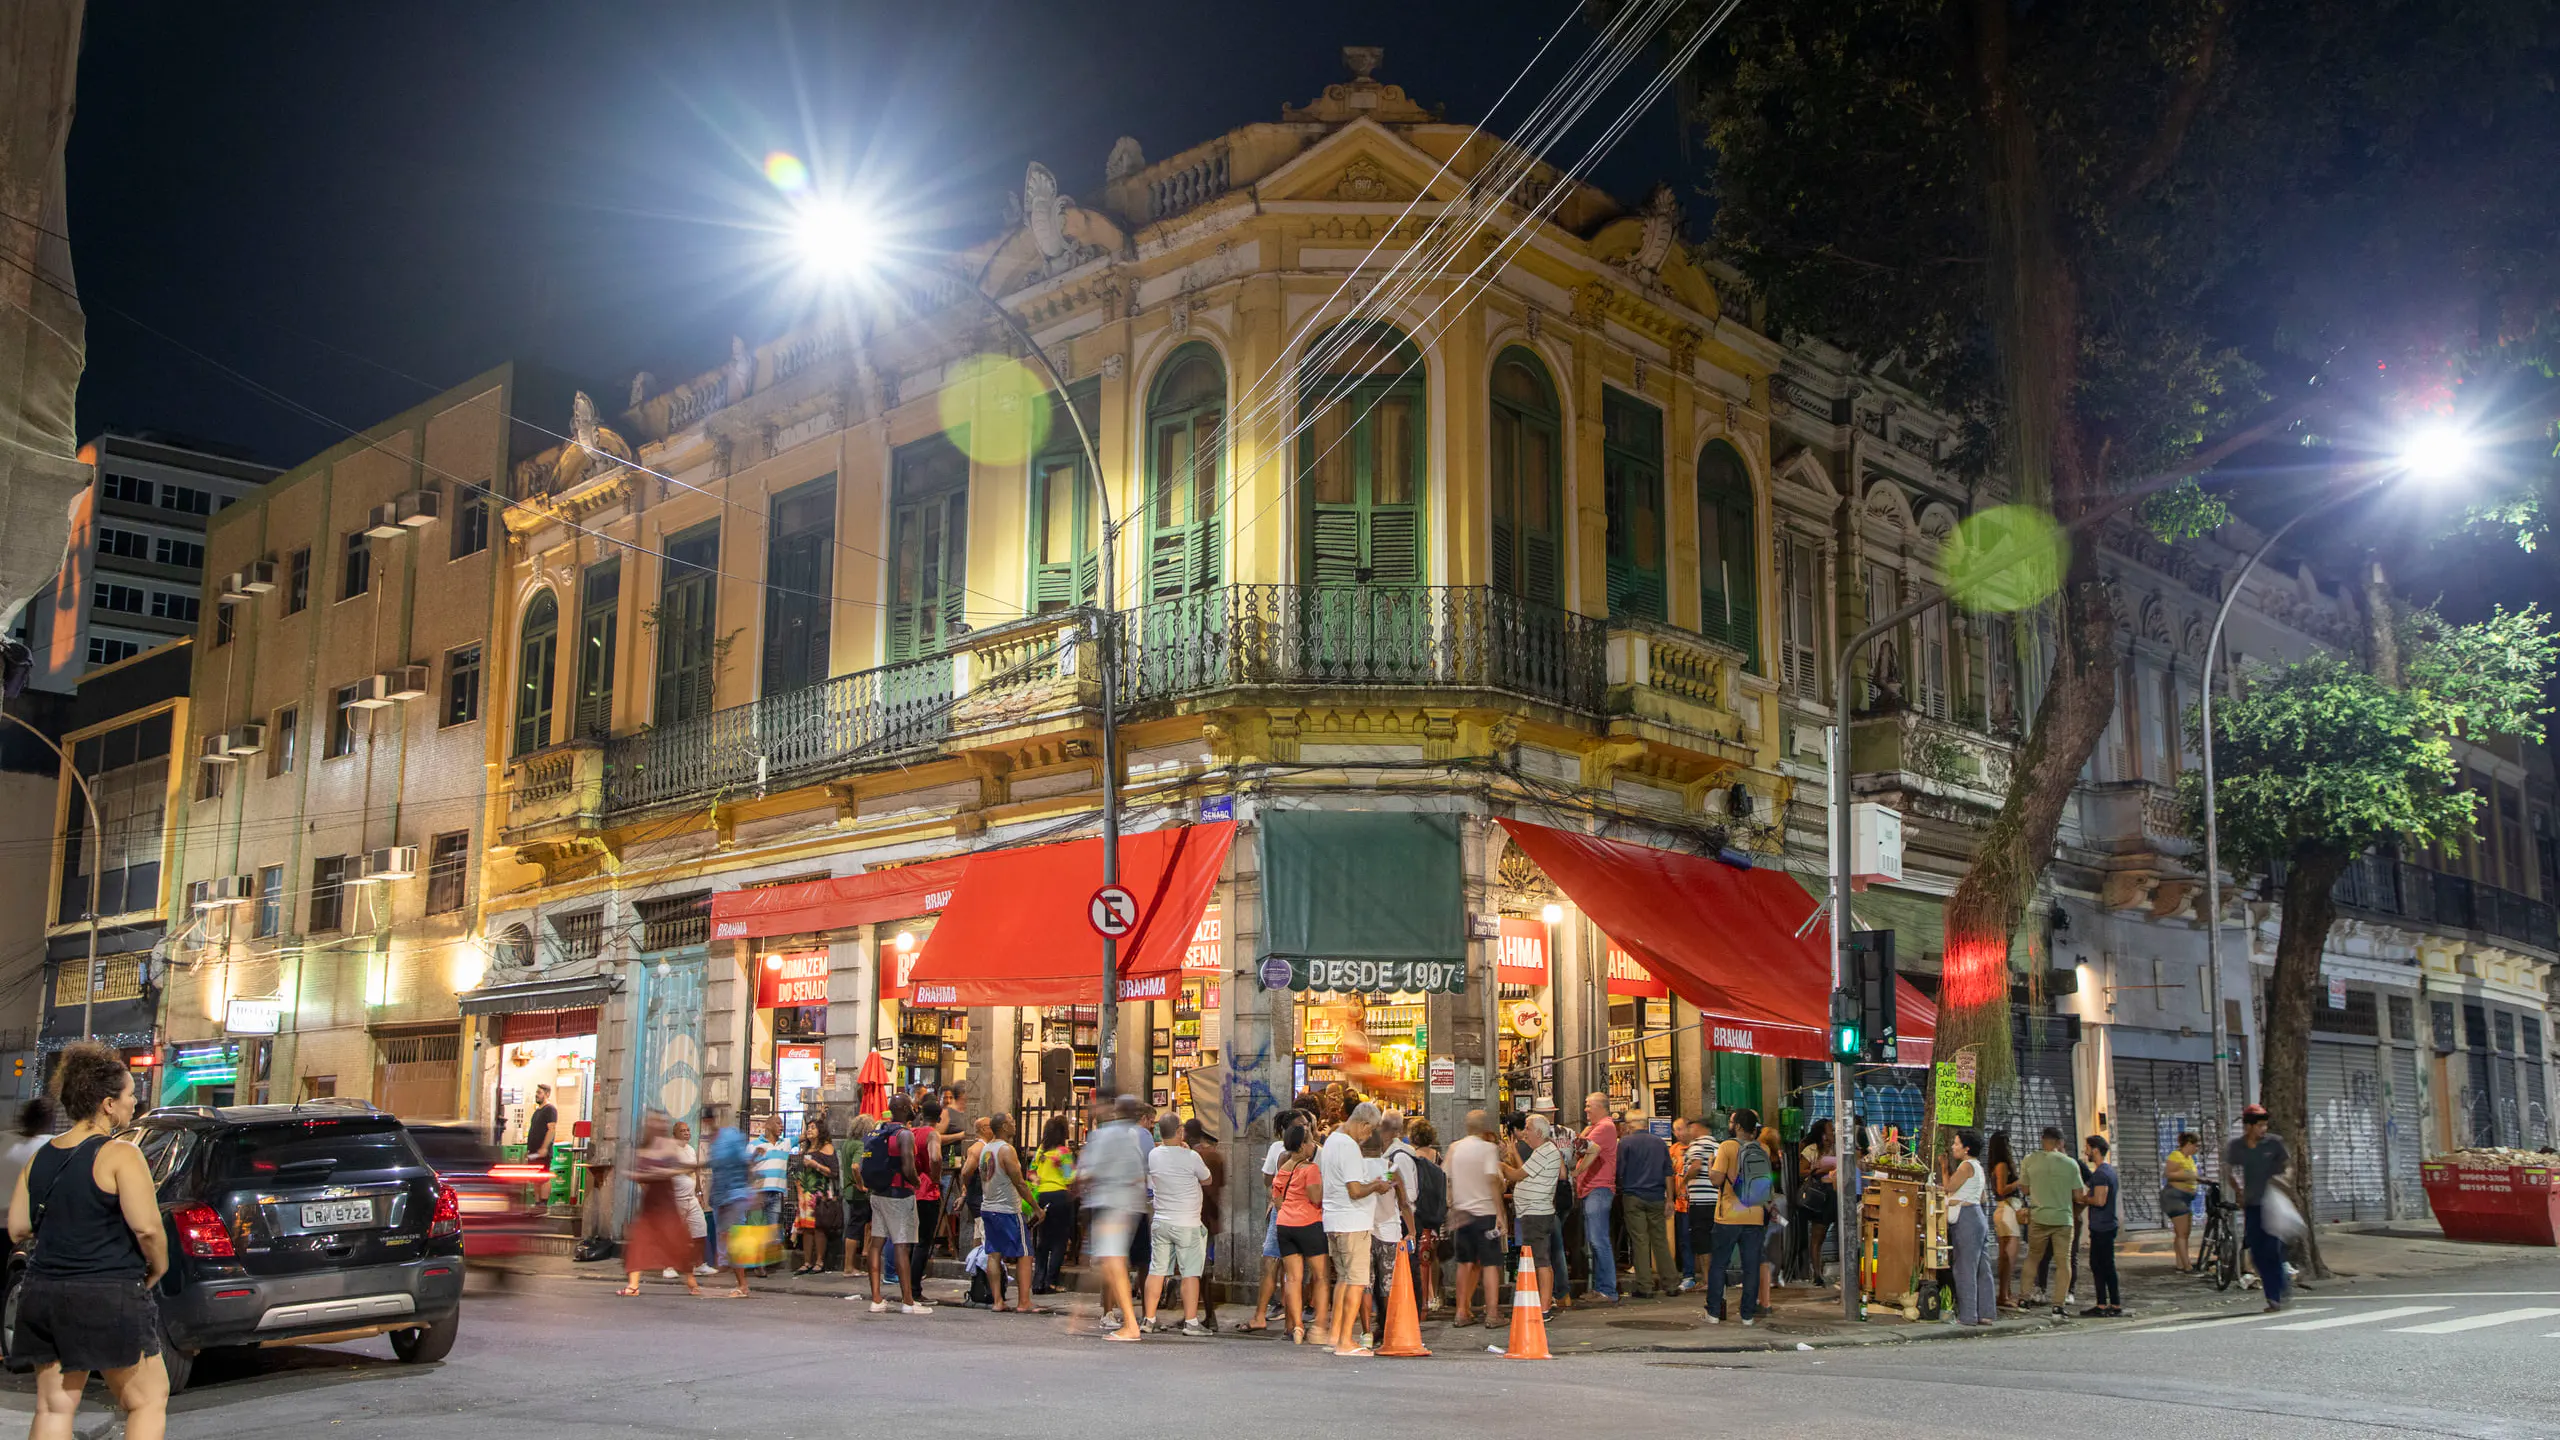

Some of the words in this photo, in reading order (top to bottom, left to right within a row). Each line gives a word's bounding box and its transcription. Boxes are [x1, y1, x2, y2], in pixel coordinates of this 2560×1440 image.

[1202, 810, 1230, 822] SENADO
[925, 890, 952, 910] BRAH
[717, 921, 748, 937] BRAHMA
[1496, 935, 1544, 969] AHMA
[780, 956, 828, 980] ARMAZEM
[1308, 960, 1394, 988] DESDE
[1401, 961, 1456, 989] 1907
[1607, 950, 1652, 982] AHMA
[778, 982, 793, 1003] DO
[916, 986, 957, 1003] BRAHMA
[1118, 976, 1166, 999] BRAHMA
[1713, 1026, 1753, 1050] BRAHMA
[788, 1048, 811, 1058] Coca-Cola
[335, 1206, 371, 1222] 9722
